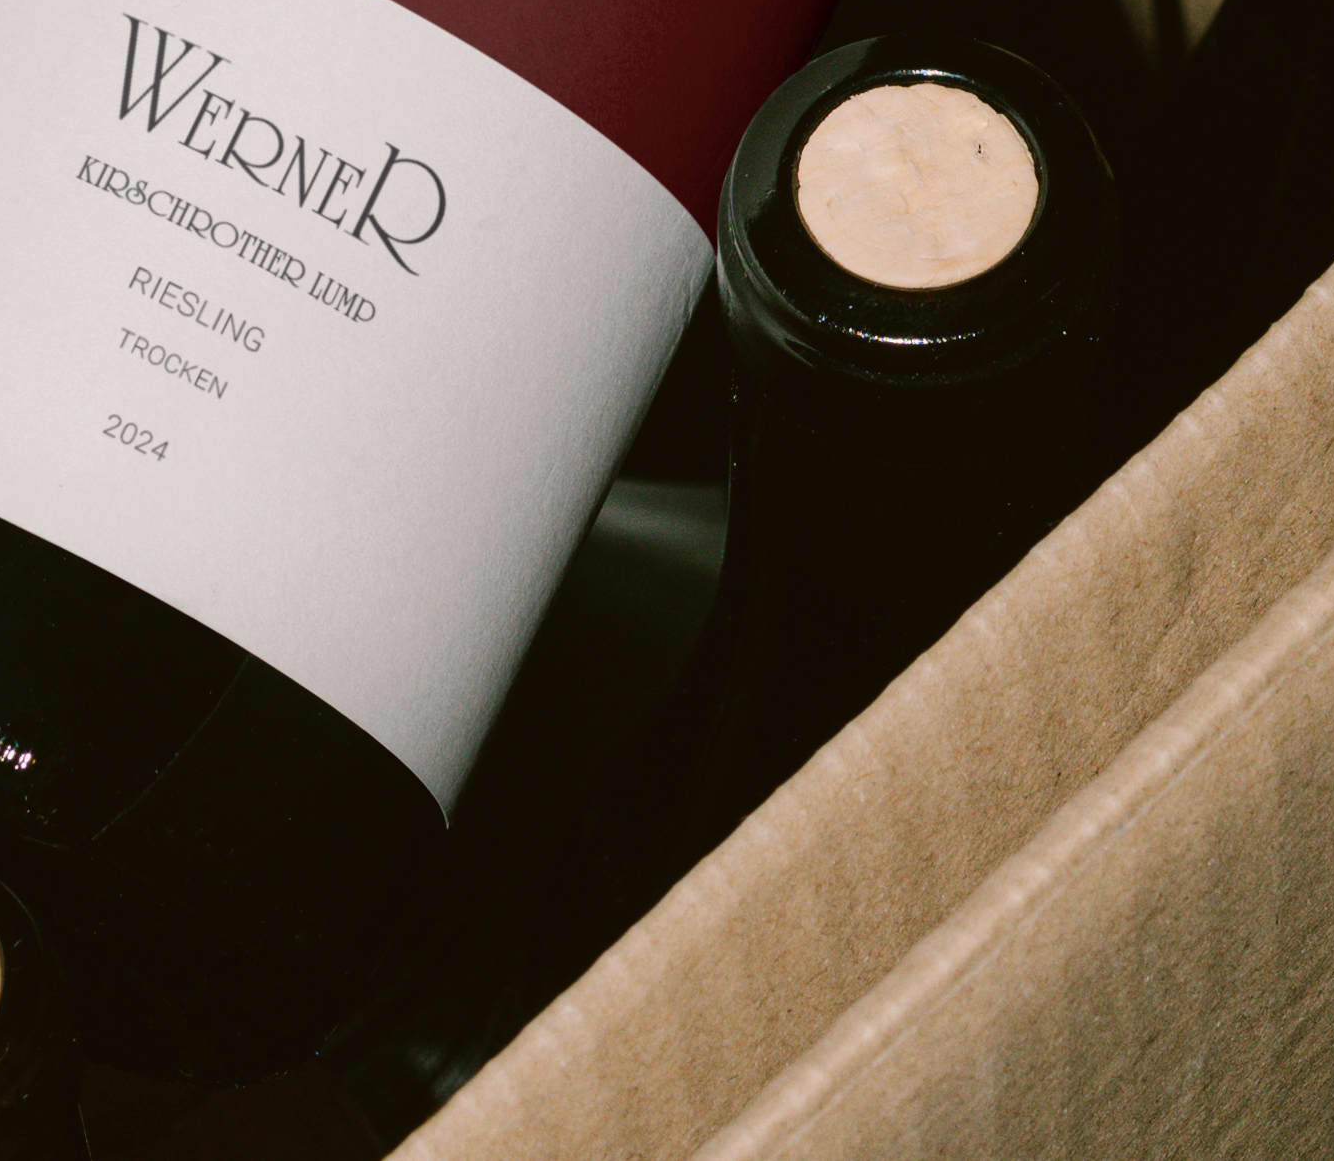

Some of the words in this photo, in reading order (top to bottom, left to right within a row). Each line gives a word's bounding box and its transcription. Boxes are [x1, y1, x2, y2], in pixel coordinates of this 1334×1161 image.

[117, 12, 447, 276] WERNER
[75, 154, 307, 288] KIRSCHROTHER
[308, 271, 377, 323] LUMP
[128, 266, 266, 353] RIESLING
[119, 327, 229, 400] TROCKEN
[102, 413, 169, 461] 2024
